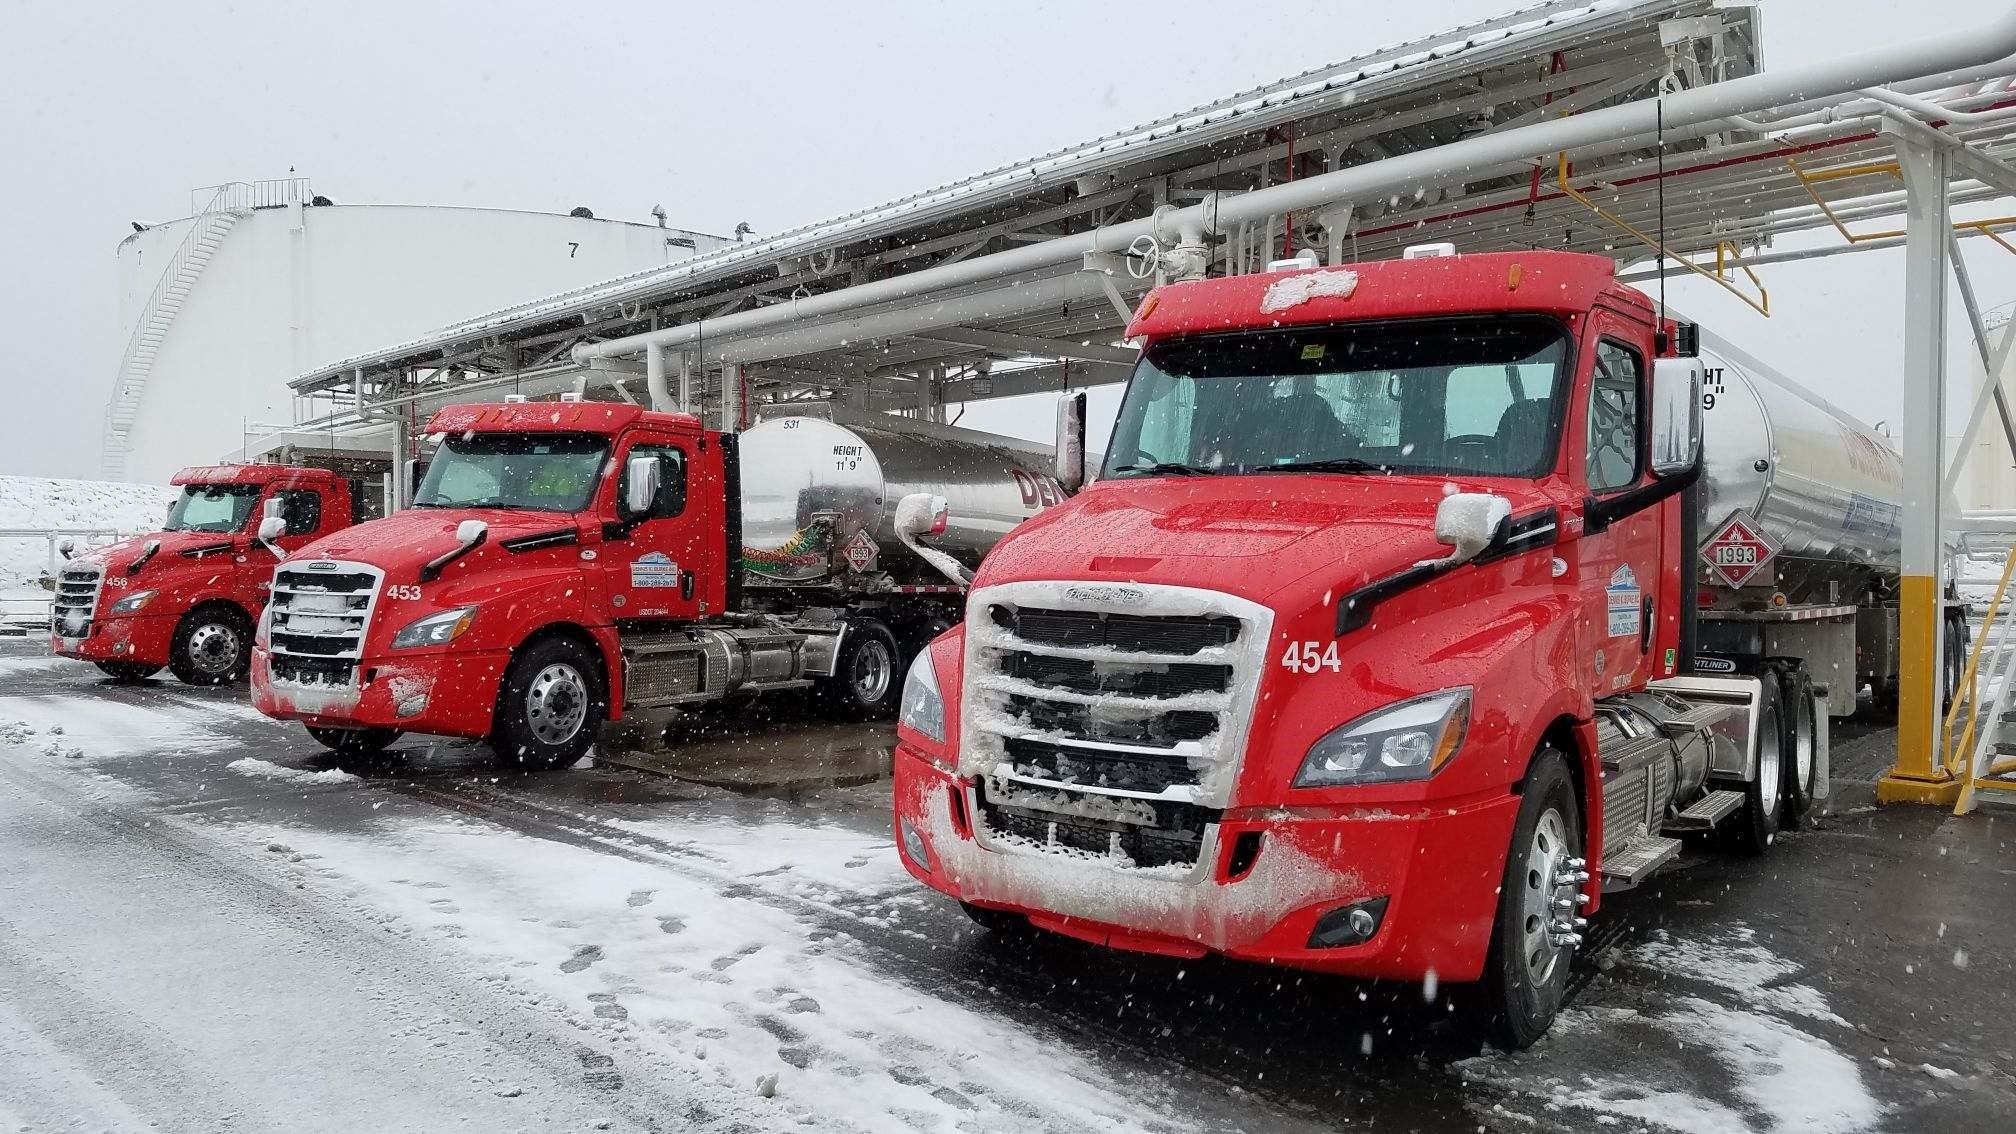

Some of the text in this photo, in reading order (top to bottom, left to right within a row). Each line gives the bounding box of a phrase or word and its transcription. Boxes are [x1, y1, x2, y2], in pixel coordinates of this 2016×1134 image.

[568, 242, 579, 258] 7
[1704, 368, 1724, 385] HT
[784, 420, 800, 429] 531
[833, 446, 862, 456] HEIGHT
[1718, 547, 1755, 563] 1993
[1733, 569, 1739, 577] 3
[107, 578, 127, 587] 456
[387, 585, 421, 600] 453
[1282, 641, 1341, 673] 454
[1695, 660, 1728, 669] HTLINER
